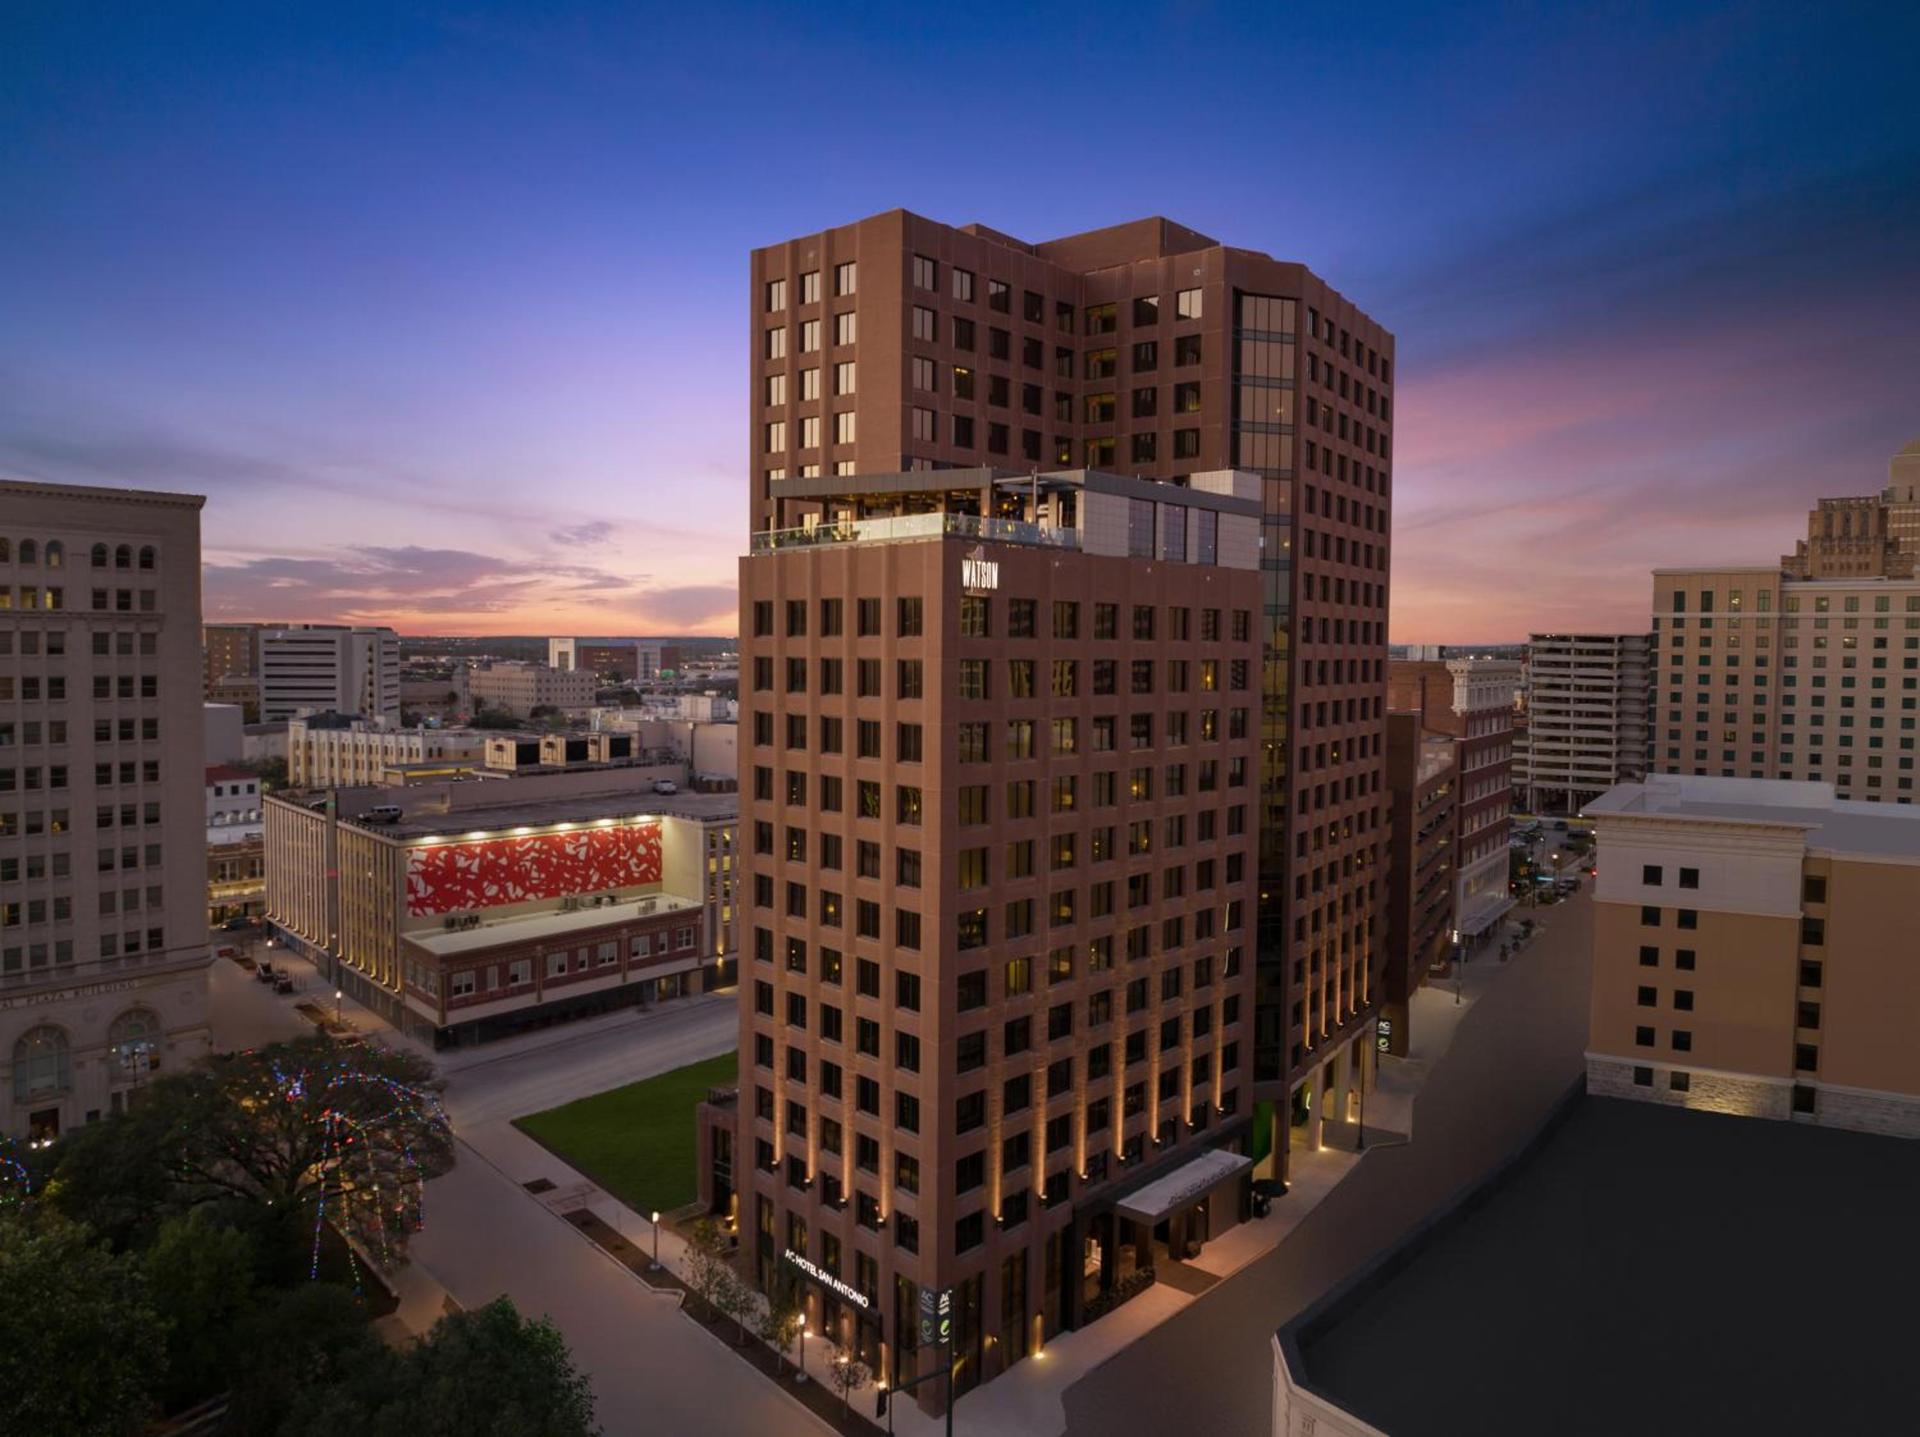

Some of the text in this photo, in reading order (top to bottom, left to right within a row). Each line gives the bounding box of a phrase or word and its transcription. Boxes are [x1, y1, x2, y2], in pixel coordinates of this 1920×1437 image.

[962, 560, 999, 589] WATSON
[26, 993, 65, 1008] PLAZA
[74, 982, 137, 997] BUILDING
[796, 1254, 818, 1277] HOTEL
[818, 1269, 833, 1287] SAN
[833, 1279, 869, 1308] ANTONIO
